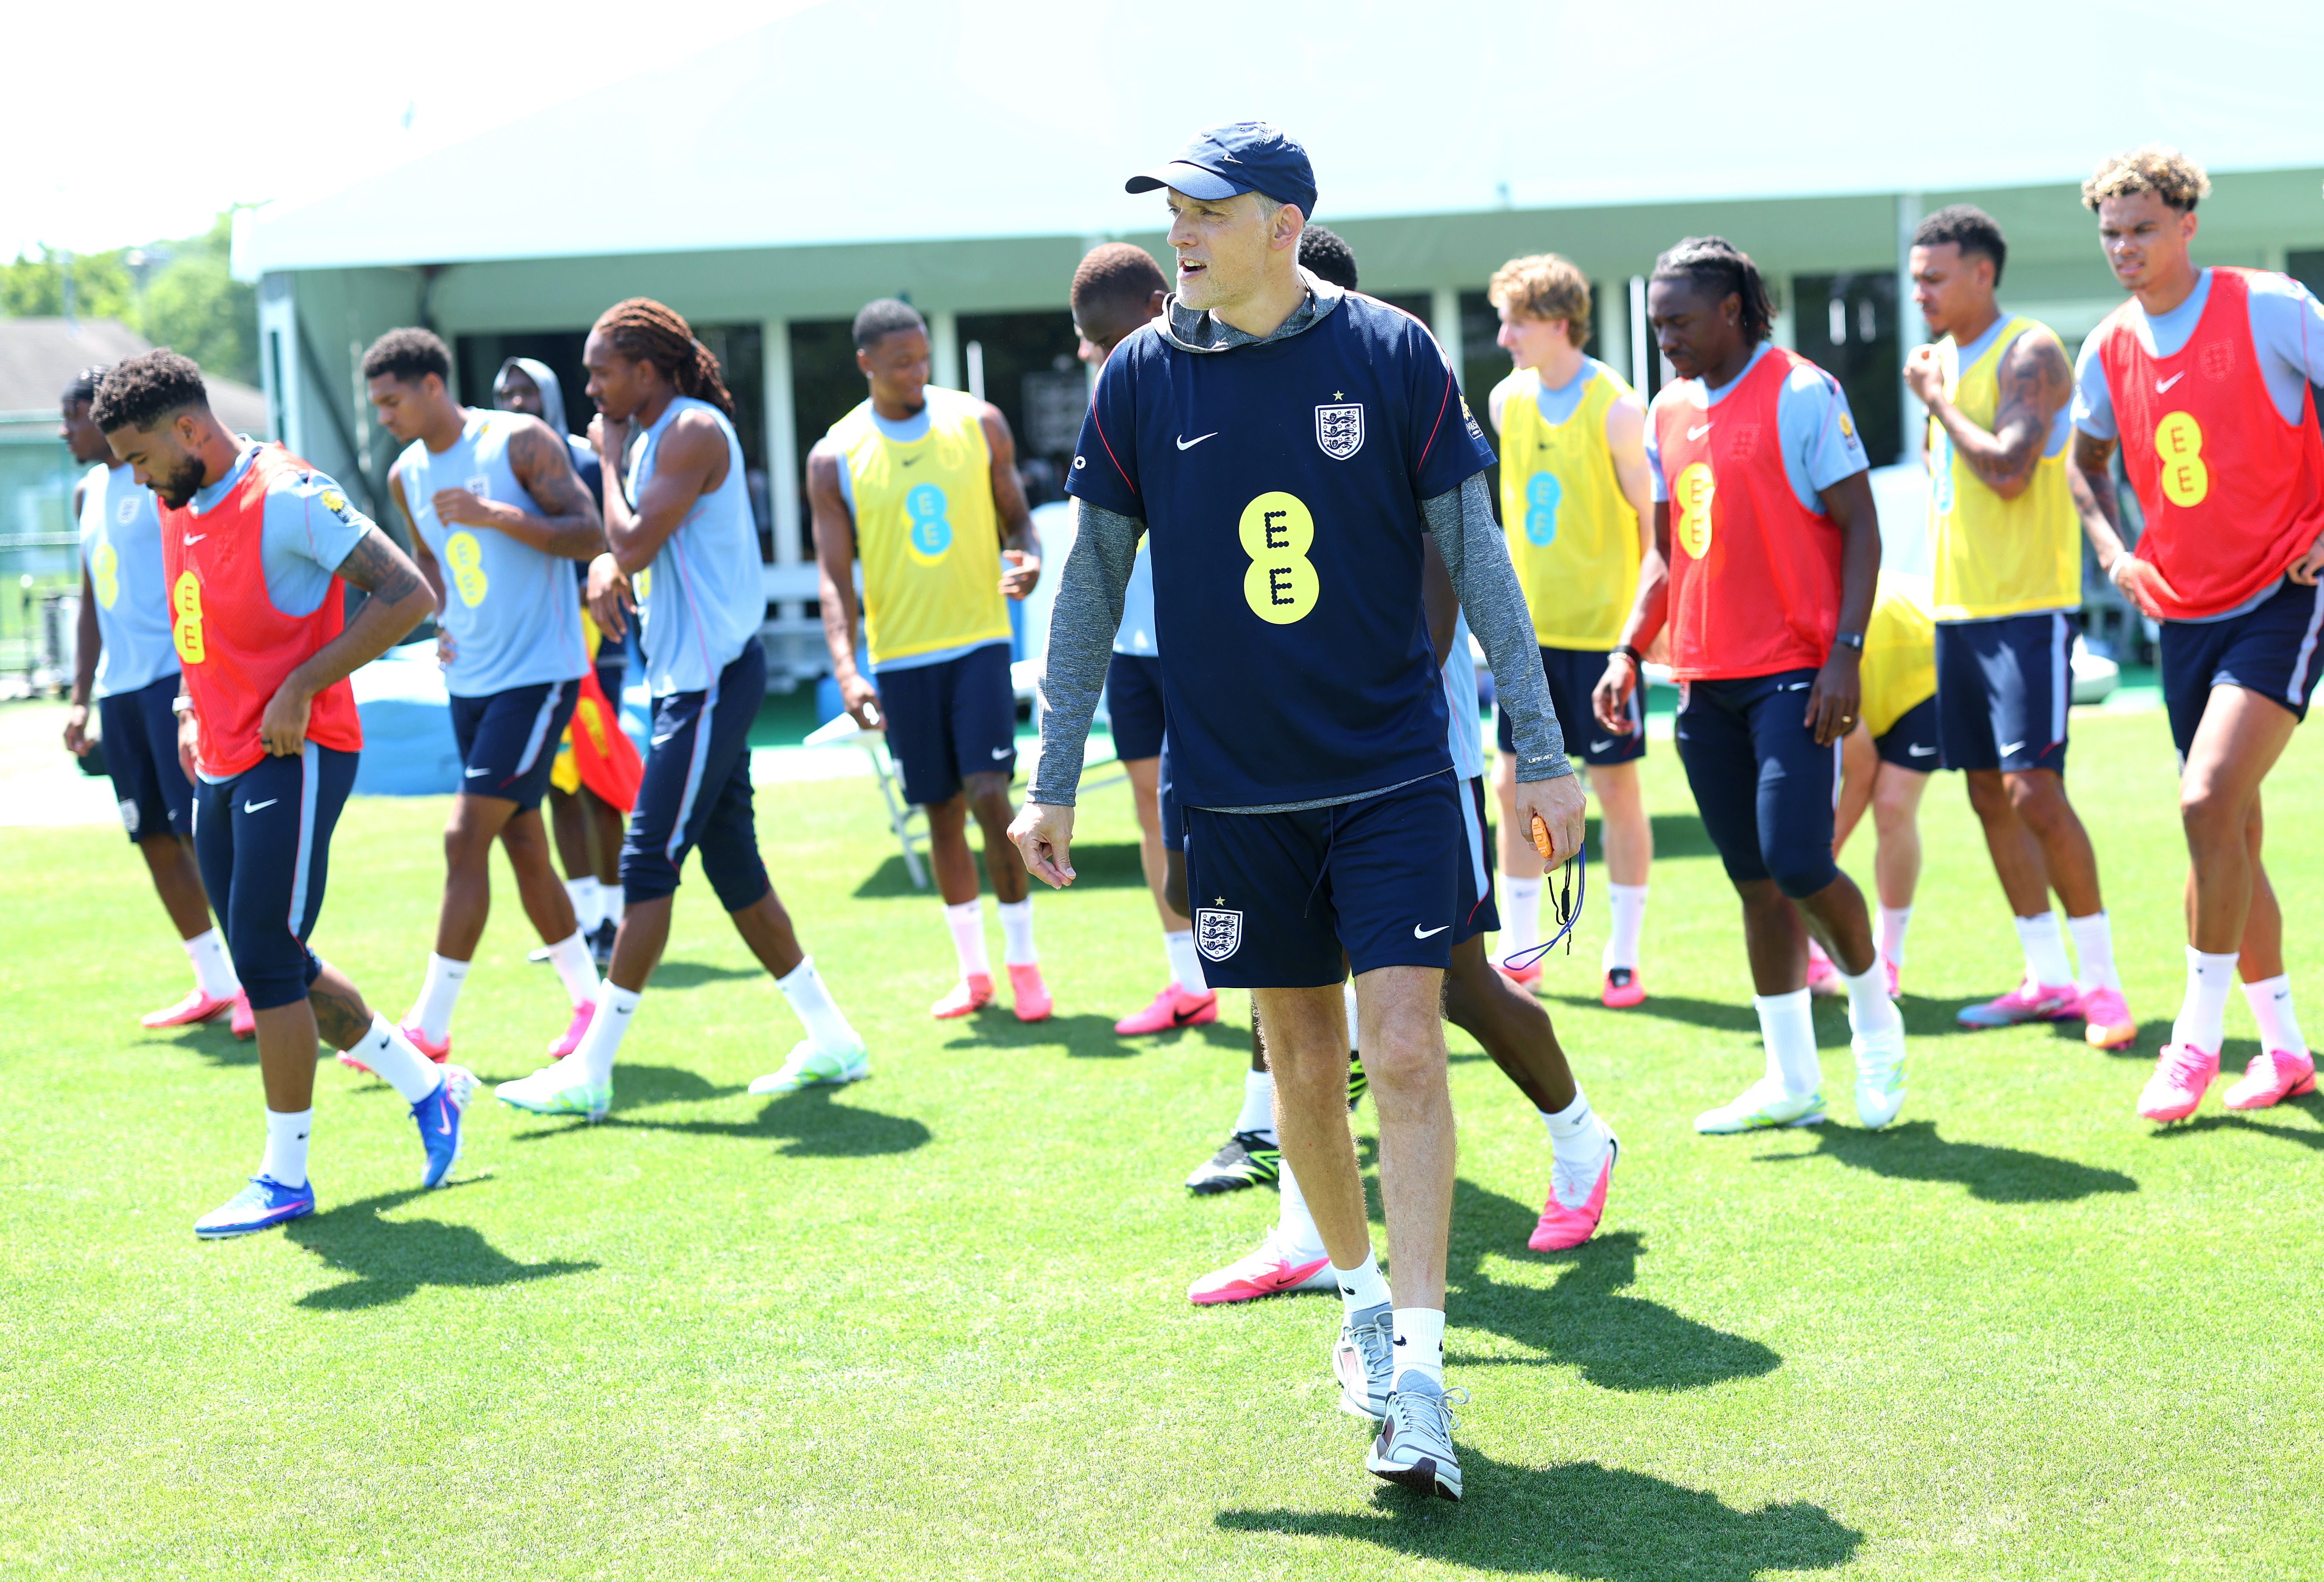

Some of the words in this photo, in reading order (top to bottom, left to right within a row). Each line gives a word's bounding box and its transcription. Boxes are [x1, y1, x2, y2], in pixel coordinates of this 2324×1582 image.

[1466, 420, 1478, 432] M&S
[2171, 426, 2194, 493] EE
[918, 493, 940, 546] EE
[1264, 511, 1294, 605] EE
